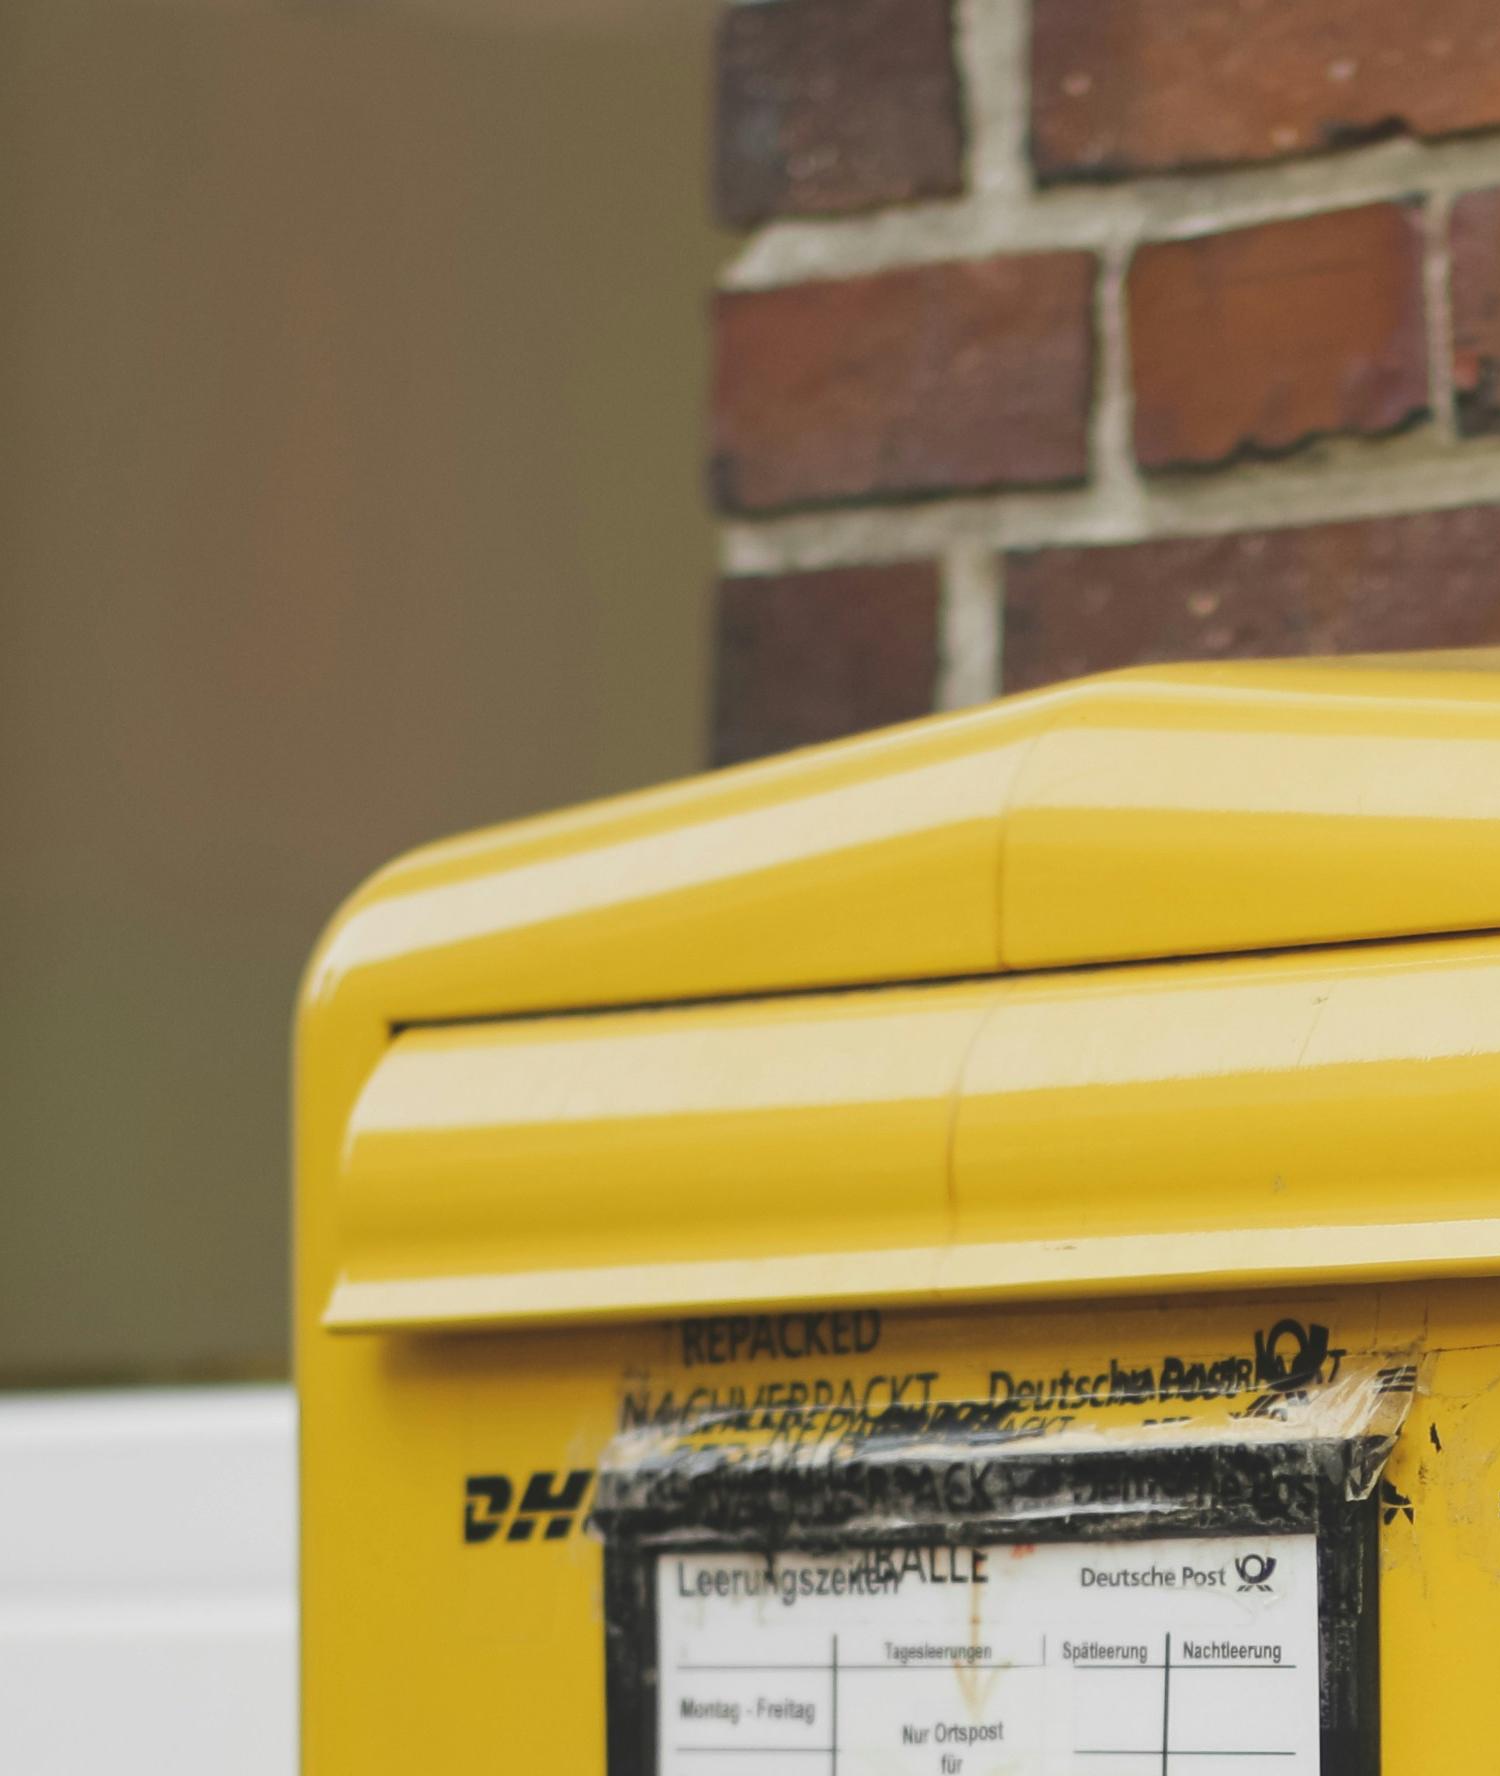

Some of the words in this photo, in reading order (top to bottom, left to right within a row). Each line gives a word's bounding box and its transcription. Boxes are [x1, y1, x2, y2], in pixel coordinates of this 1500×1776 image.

[682, 1309, 881, 1367] REPACKED
[465, 1470, 594, 1543] DH
[862, 1545, 989, 1584] BALLE
[677, 1561, 899, 1605] Leerungszeiten
[1081, 1566, 1176, 1588] Deutsche
[1181, 1566, 1227, 1587] Post
[884, 1641, 992, 1664] Tagesleerungen
[1062, 1641, 1148, 1663] Spätleerung
[1183, 1641, 1282, 1663] Nachtleerung
[680, 1698, 740, 1724] Montag
[756, 1698, 815, 1724] Freitag
[902, 1725, 929, 1744] Nur
[934, 1722, 1004, 1746] Ortspost
[940, 1754, 962, 1774] für
